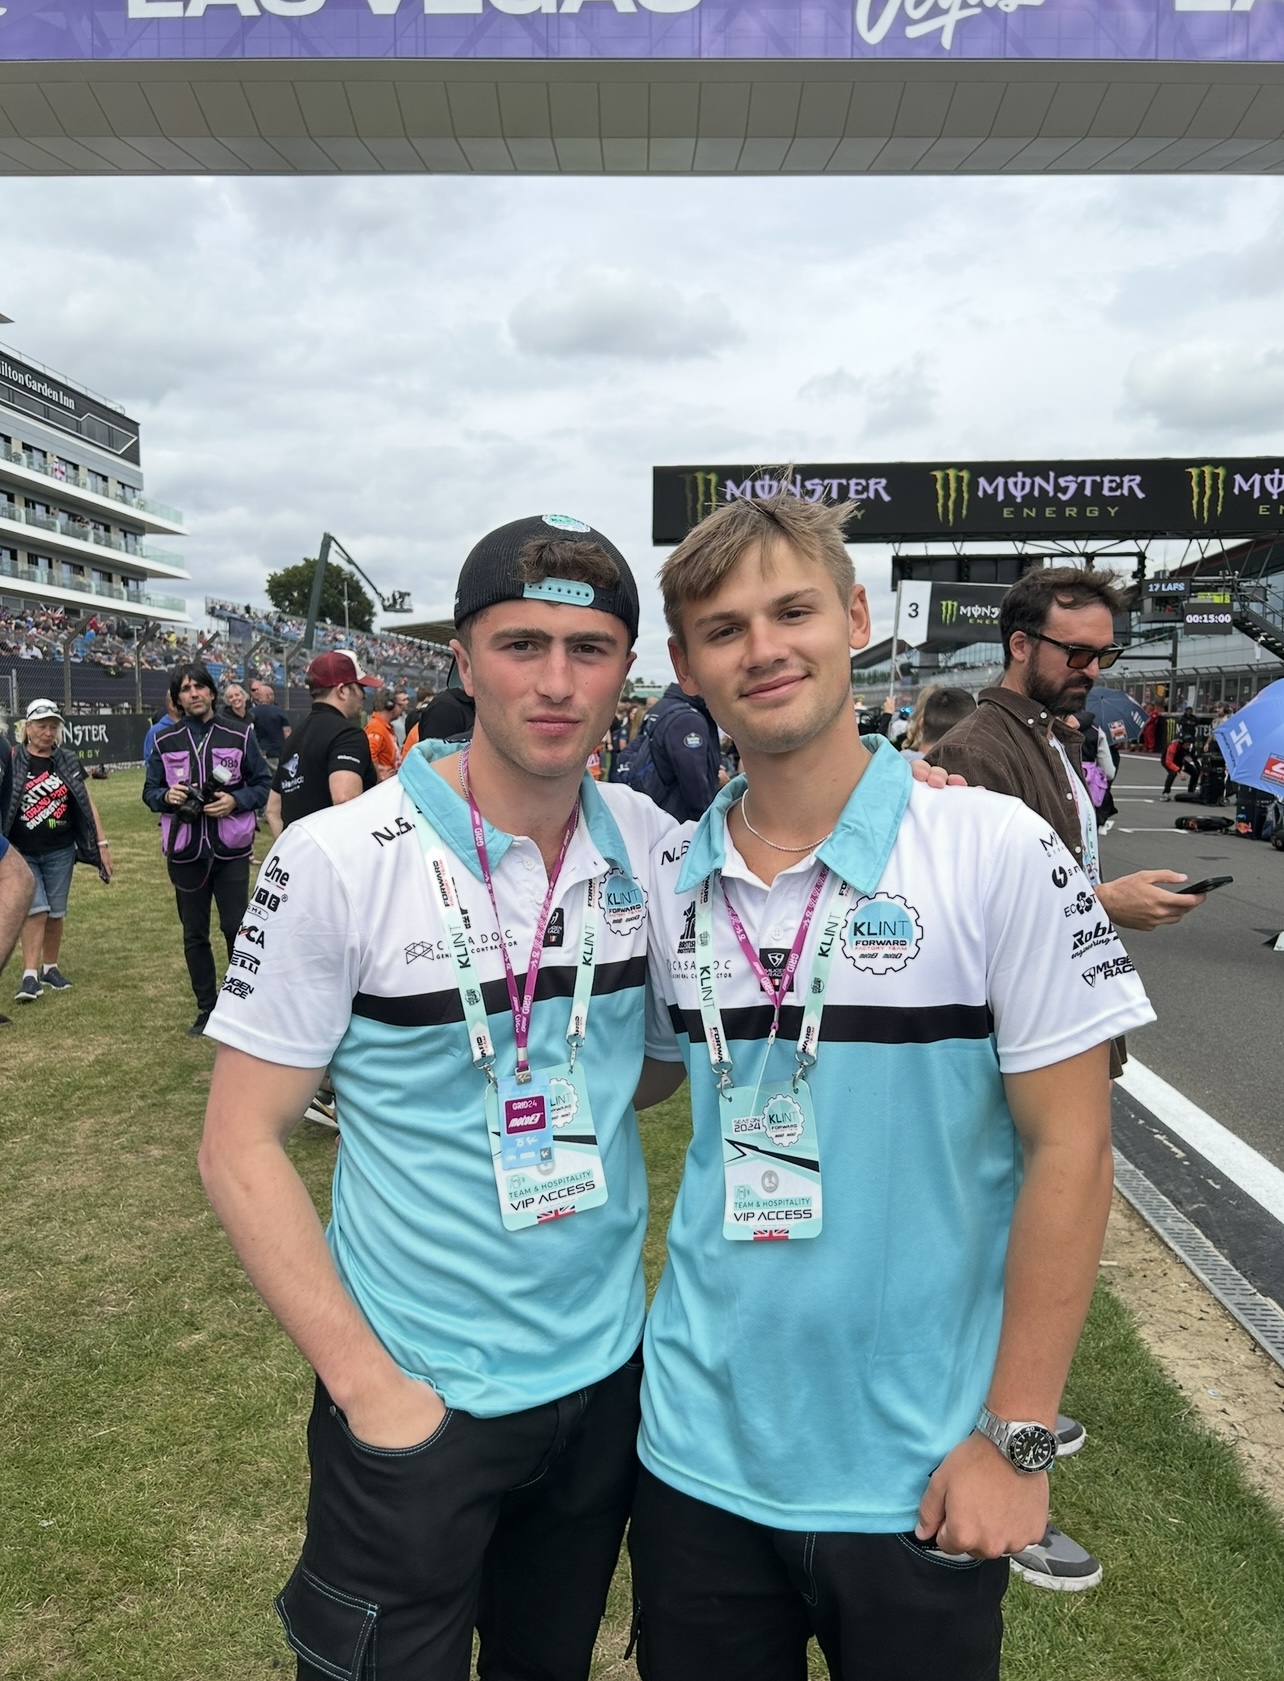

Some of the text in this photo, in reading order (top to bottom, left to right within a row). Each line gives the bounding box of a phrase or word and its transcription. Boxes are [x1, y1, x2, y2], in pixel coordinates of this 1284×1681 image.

[25, 373, 59, 402] Garden
[59, 391, 76, 410] Inn
[977, 470, 1146, 503] MONSTER
[1003, 506, 1120, 518] ENERGY
[1148, 582, 1185, 592] 17 LAPS
[908, 602, 919, 618] 3
[1186, 613, 1232, 624] 00:15:00
[264, 855, 290, 887] One
[433, 860, 450, 907] FORWARD
[607, 888, 638, 906] KLINT
[609, 904, 642, 914] FORWARD
[818, 911, 841, 957] KLINT
[854, 921, 909, 937] KLINT
[448, 925, 472, 969] KLINT
[582, 922, 595, 967] KLINT
[787, 953, 799, 973] GRID
[700, 966, 715, 1010] KLINT
[760, 977, 774, 995] GRID
[522, 995, 532, 1015] GRID
[512, 1100, 538, 1110] GRID24
[769, 1111, 798, 1124] KLINT
[734, 1123, 761, 1133] 2024
[509, 1188, 531, 1199] TEAM
[541, 1170, 592, 1191] HOSPITALITY
[510, 1196, 534, 1211] VIP
[538, 1180, 596, 1205] ACCESS
[762, 1197, 810, 1207] HOSPITALITY
[733, 1208, 812, 1222] VIP ACCESS
